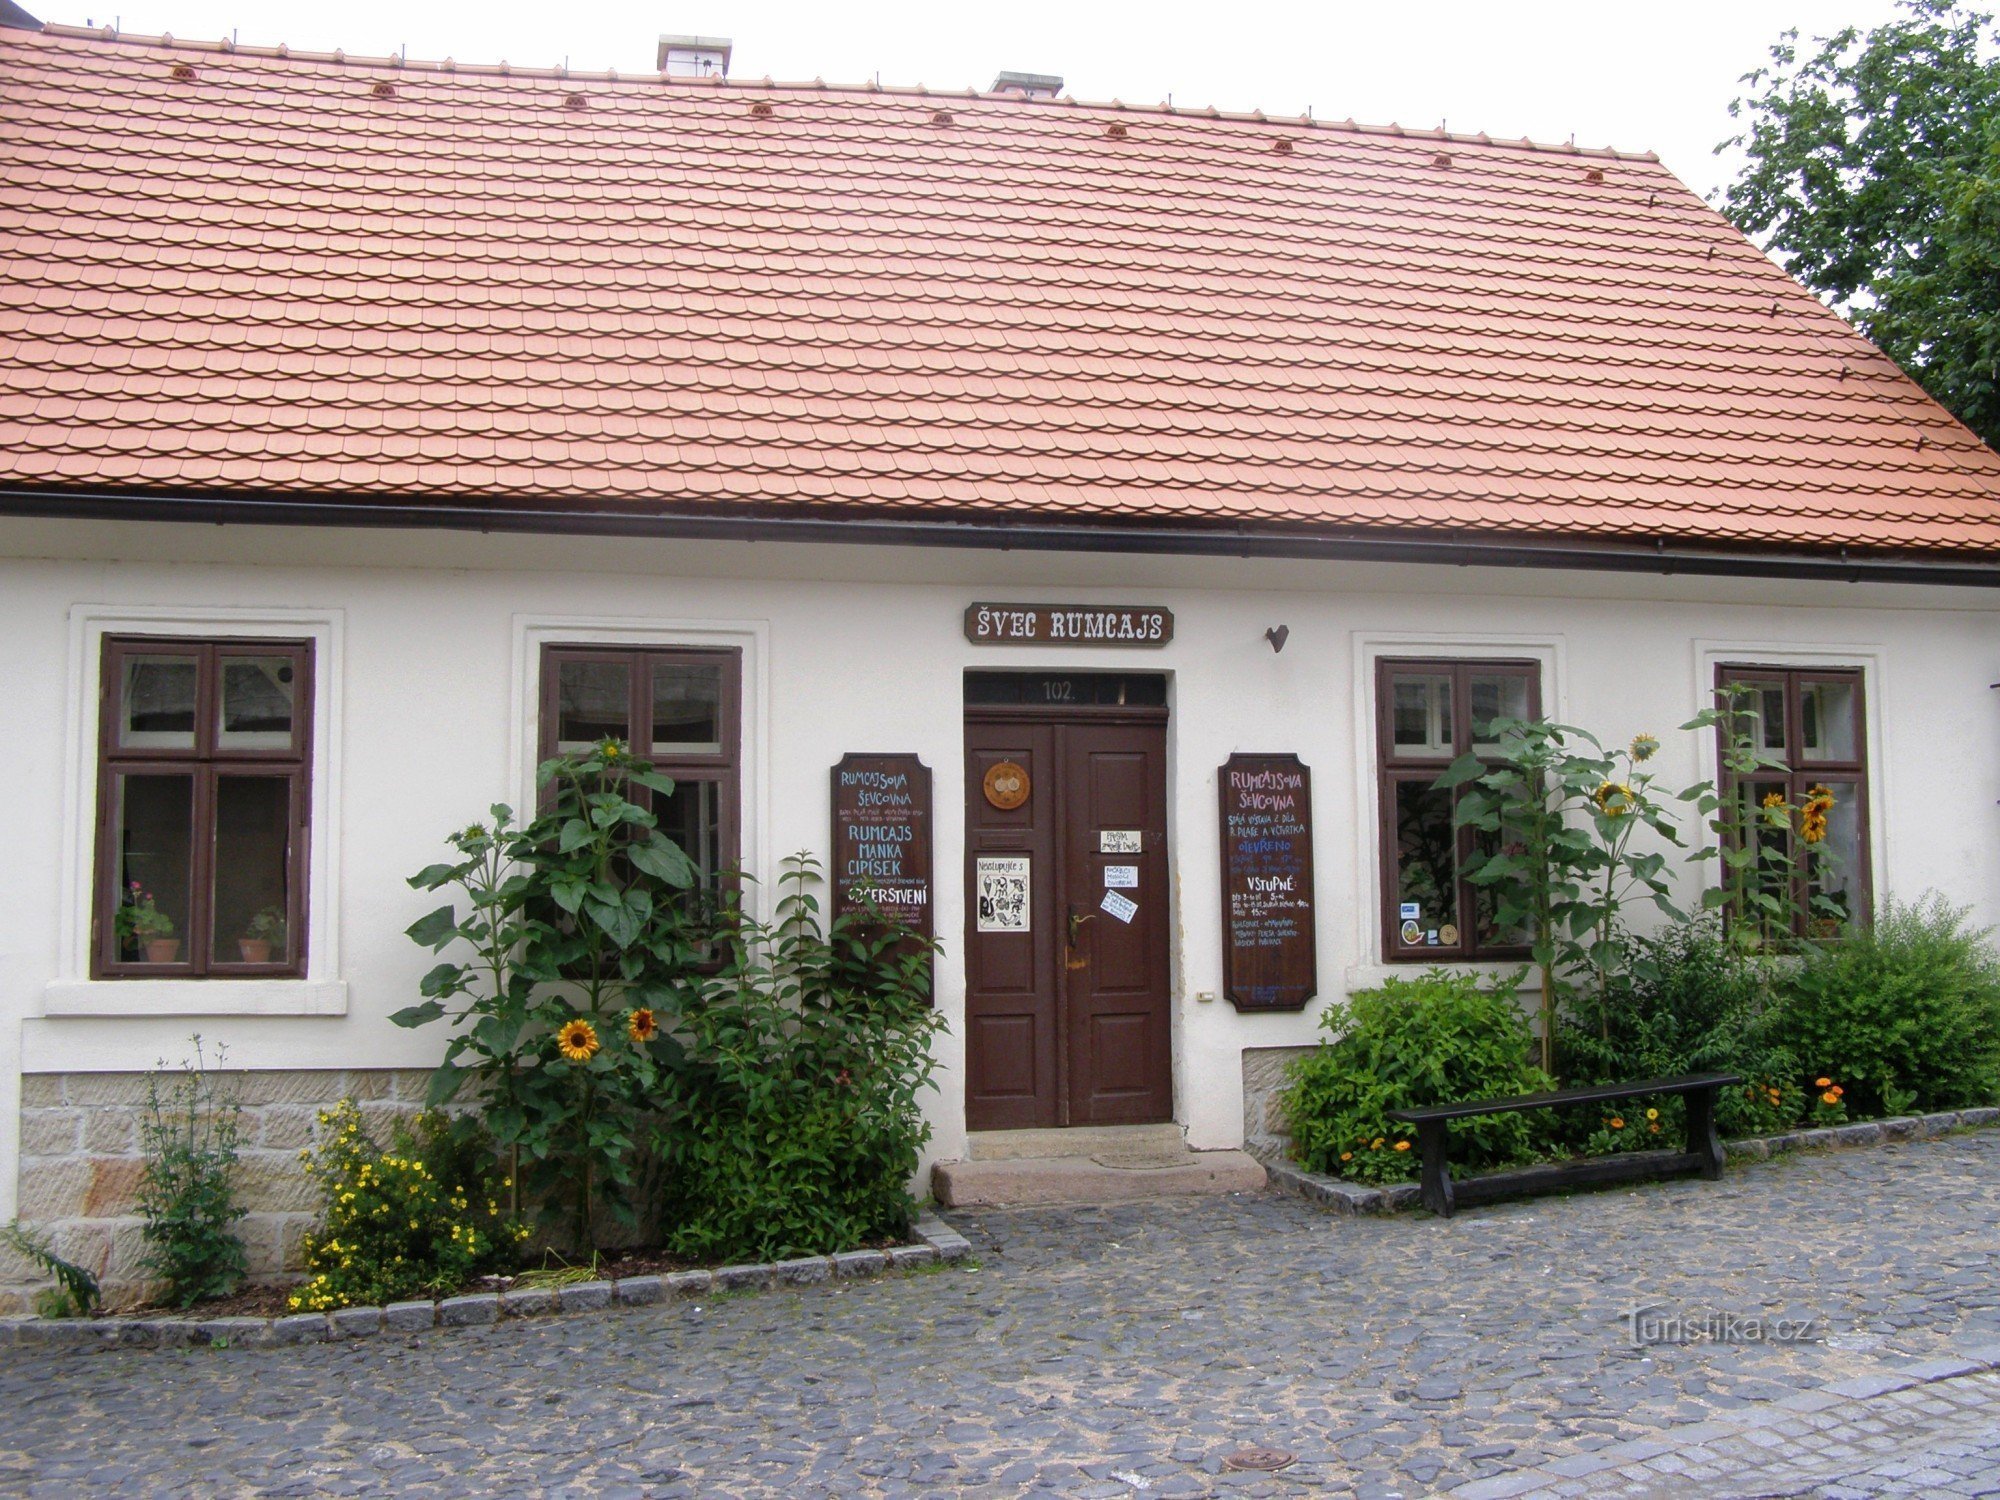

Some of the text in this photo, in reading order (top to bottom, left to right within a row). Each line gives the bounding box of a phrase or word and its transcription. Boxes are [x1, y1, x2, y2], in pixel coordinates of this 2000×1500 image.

[977, 606, 1163, 639] ŠVEC RUMCAJS
[849, 825, 912, 841] RUMCAJS
